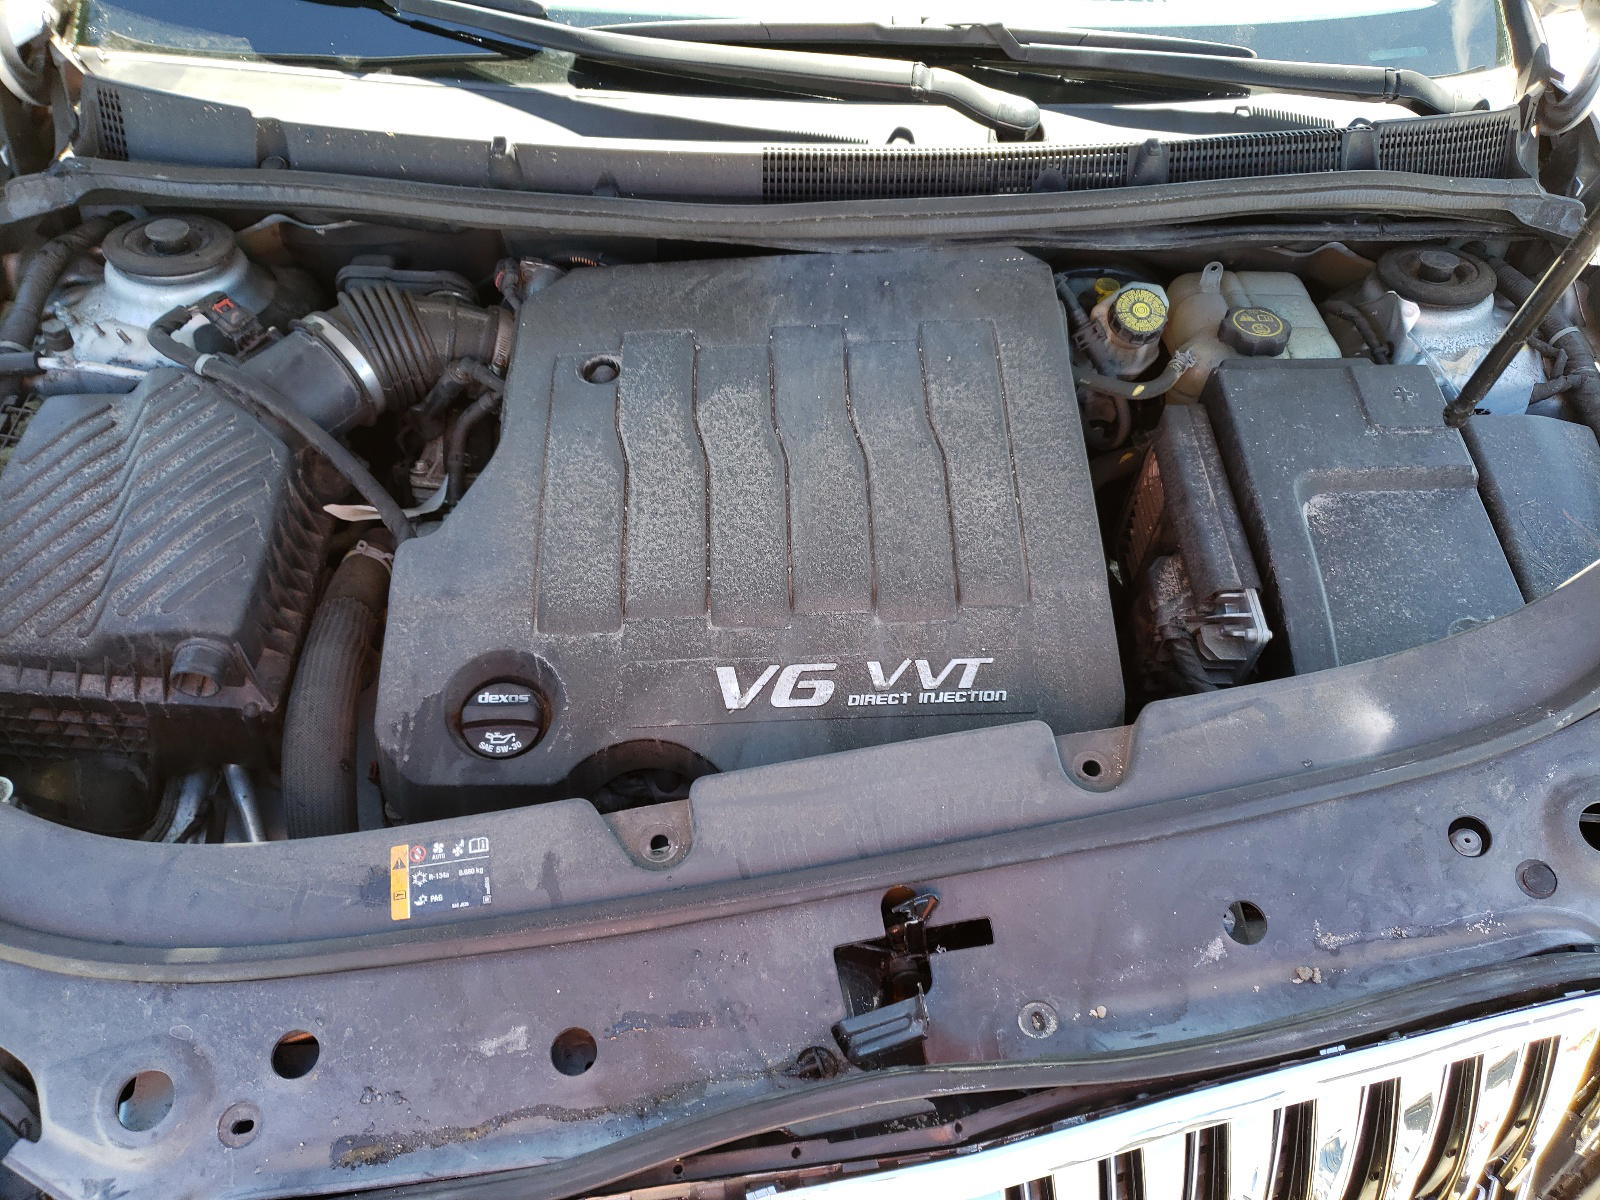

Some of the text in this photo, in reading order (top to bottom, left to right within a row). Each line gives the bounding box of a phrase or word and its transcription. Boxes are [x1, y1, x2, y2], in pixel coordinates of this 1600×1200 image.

[715, 657, 994, 710] V6 VVT
[478, 692, 530, 704] dexos
[847, 690, 1007, 706] DIRECT INJECTION
[479, 741, 522, 753] SAE 5W-30
[428, 871, 449, 880] R-134a
